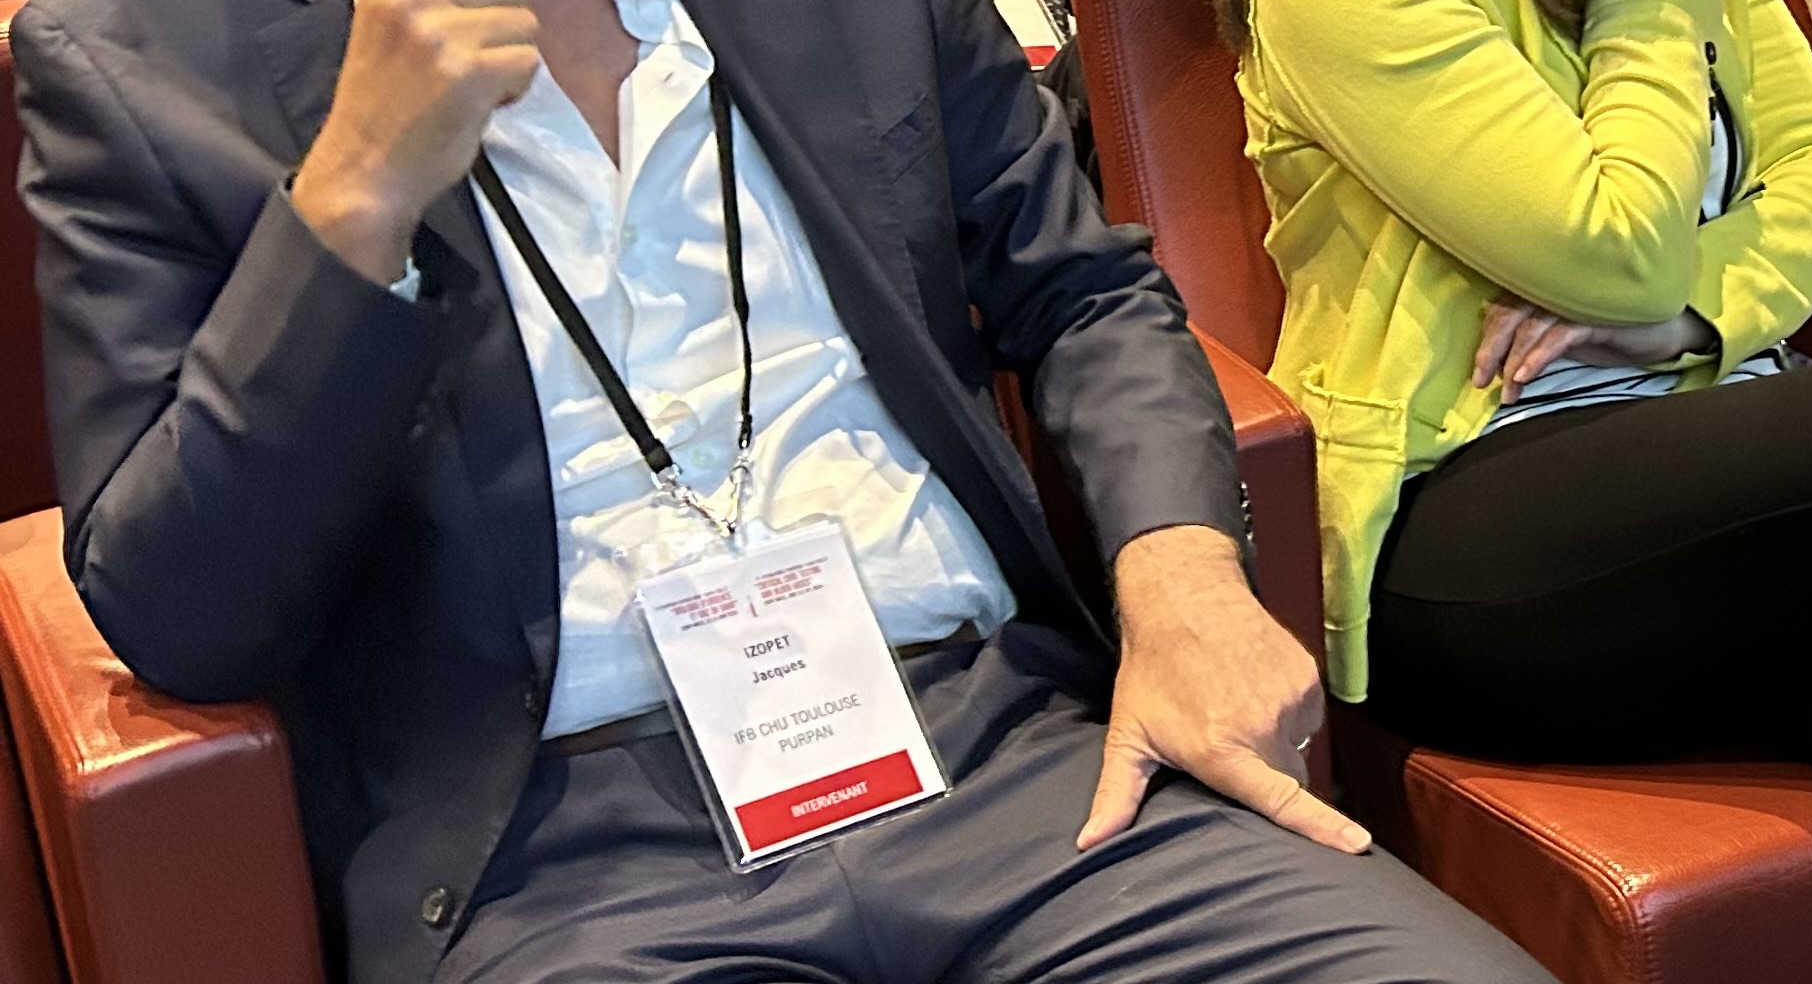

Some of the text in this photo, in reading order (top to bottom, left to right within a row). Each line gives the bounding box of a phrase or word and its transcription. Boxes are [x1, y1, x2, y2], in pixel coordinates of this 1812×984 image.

[744, 635, 791, 659] IZOPET
[752, 659, 806, 684] Jacques
[734, 693, 861, 745] IFB CHU TOULOUSE
[778, 725, 833, 753] PURPAN
[791, 781, 868, 818] INTERVENANT
